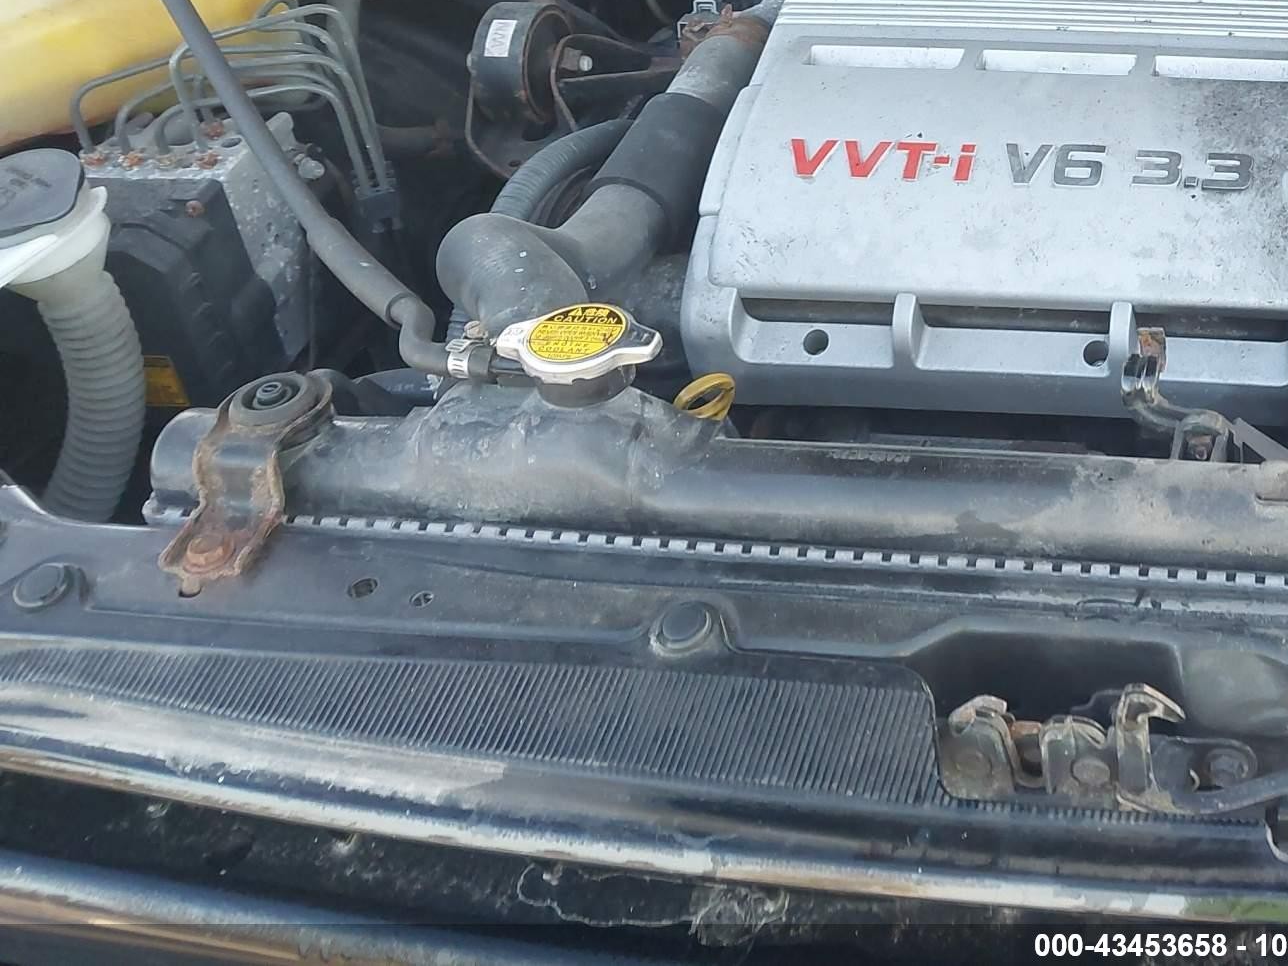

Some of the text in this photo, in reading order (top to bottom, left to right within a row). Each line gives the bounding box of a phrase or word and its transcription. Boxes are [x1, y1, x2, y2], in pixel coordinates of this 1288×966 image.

[791, 137, 1255, 191] VVT-i V6 3.3
[553, 314, 618, 324] CAUTION
